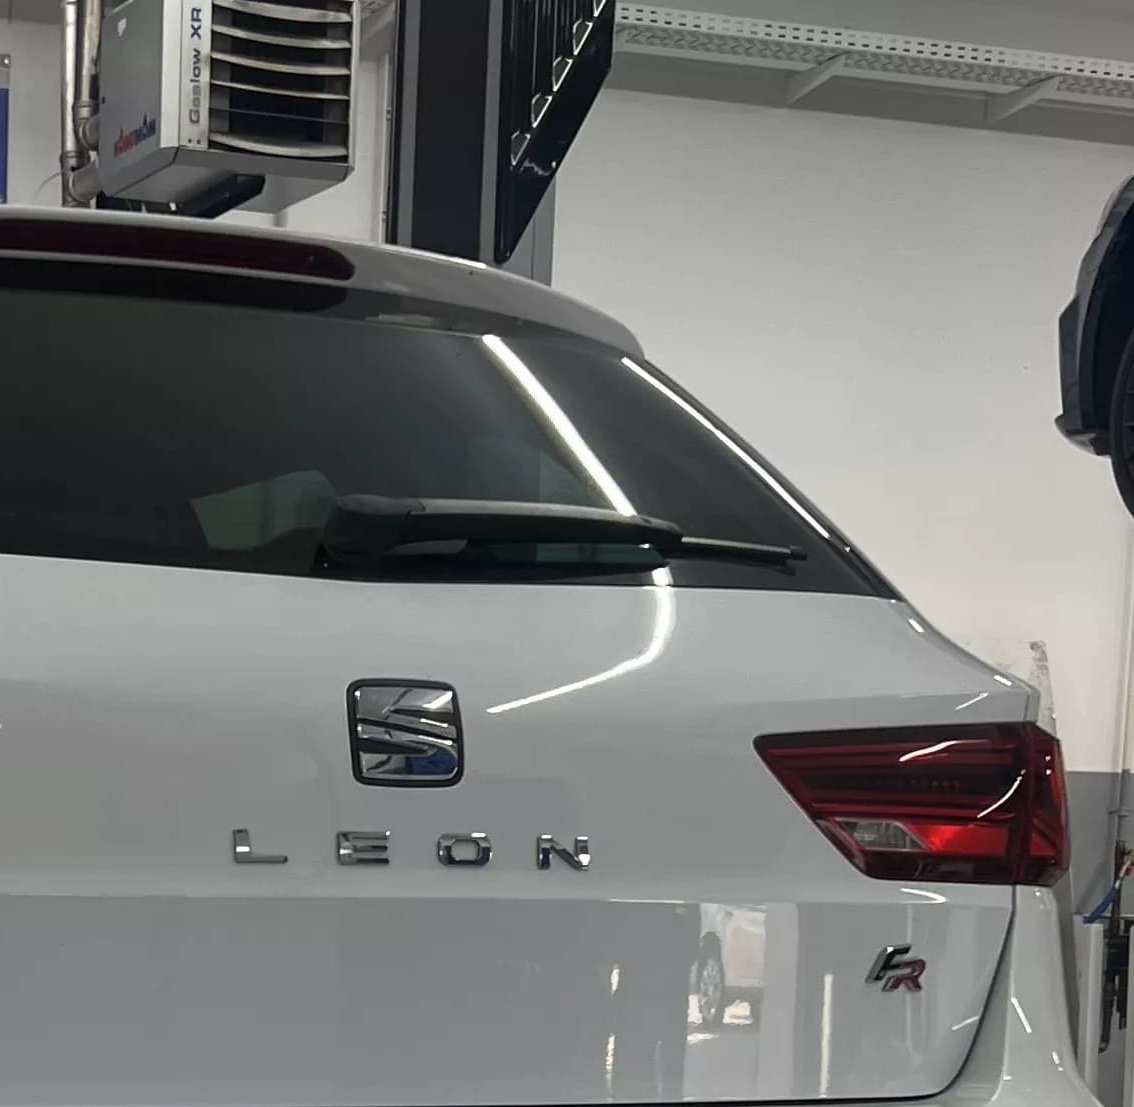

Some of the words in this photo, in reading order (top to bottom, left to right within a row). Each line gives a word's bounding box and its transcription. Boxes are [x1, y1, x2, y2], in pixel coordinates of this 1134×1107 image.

[191, 8, 202, 40] XR
[232, 828, 591, 871] LEON
[865, 944, 926, 992] FR
